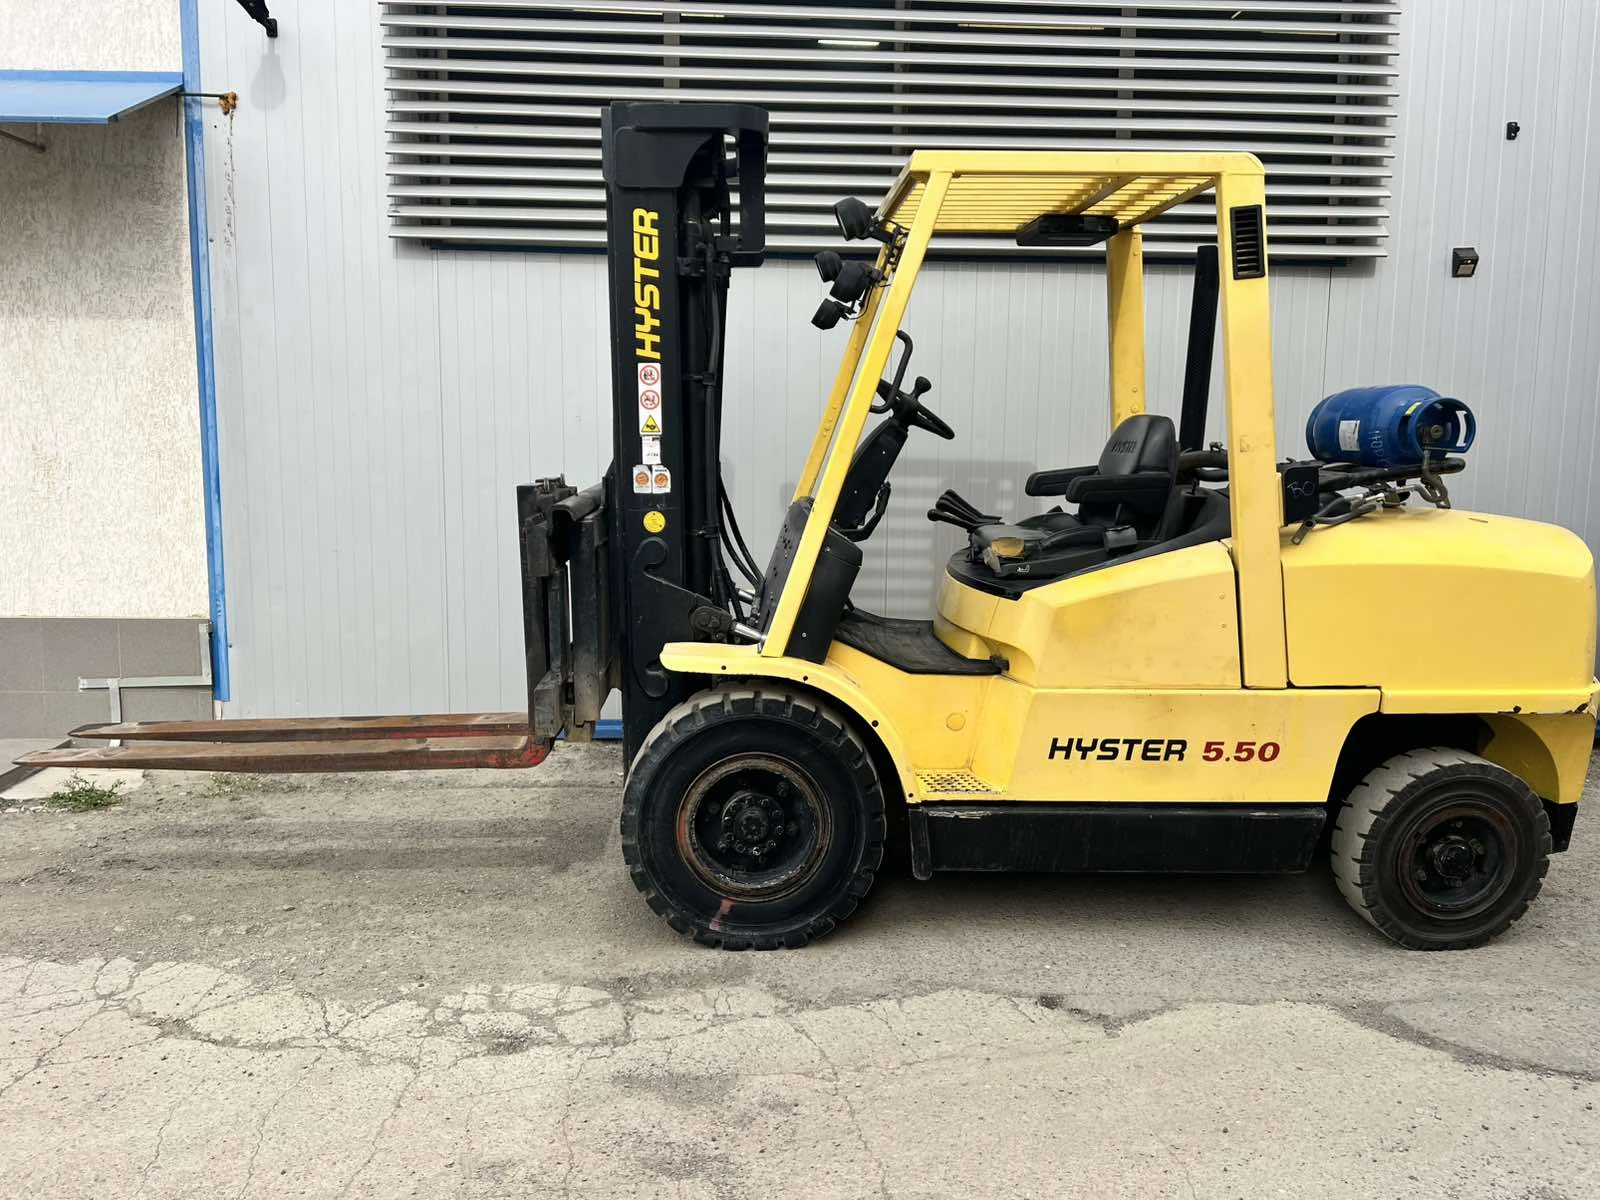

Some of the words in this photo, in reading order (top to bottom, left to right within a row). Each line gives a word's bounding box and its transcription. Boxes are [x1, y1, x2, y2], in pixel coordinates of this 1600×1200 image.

[633, 207, 661, 359] HYSTER
[1048, 737, 1188, 761] HYSTER
[1202, 741, 1281, 762] 5.50
